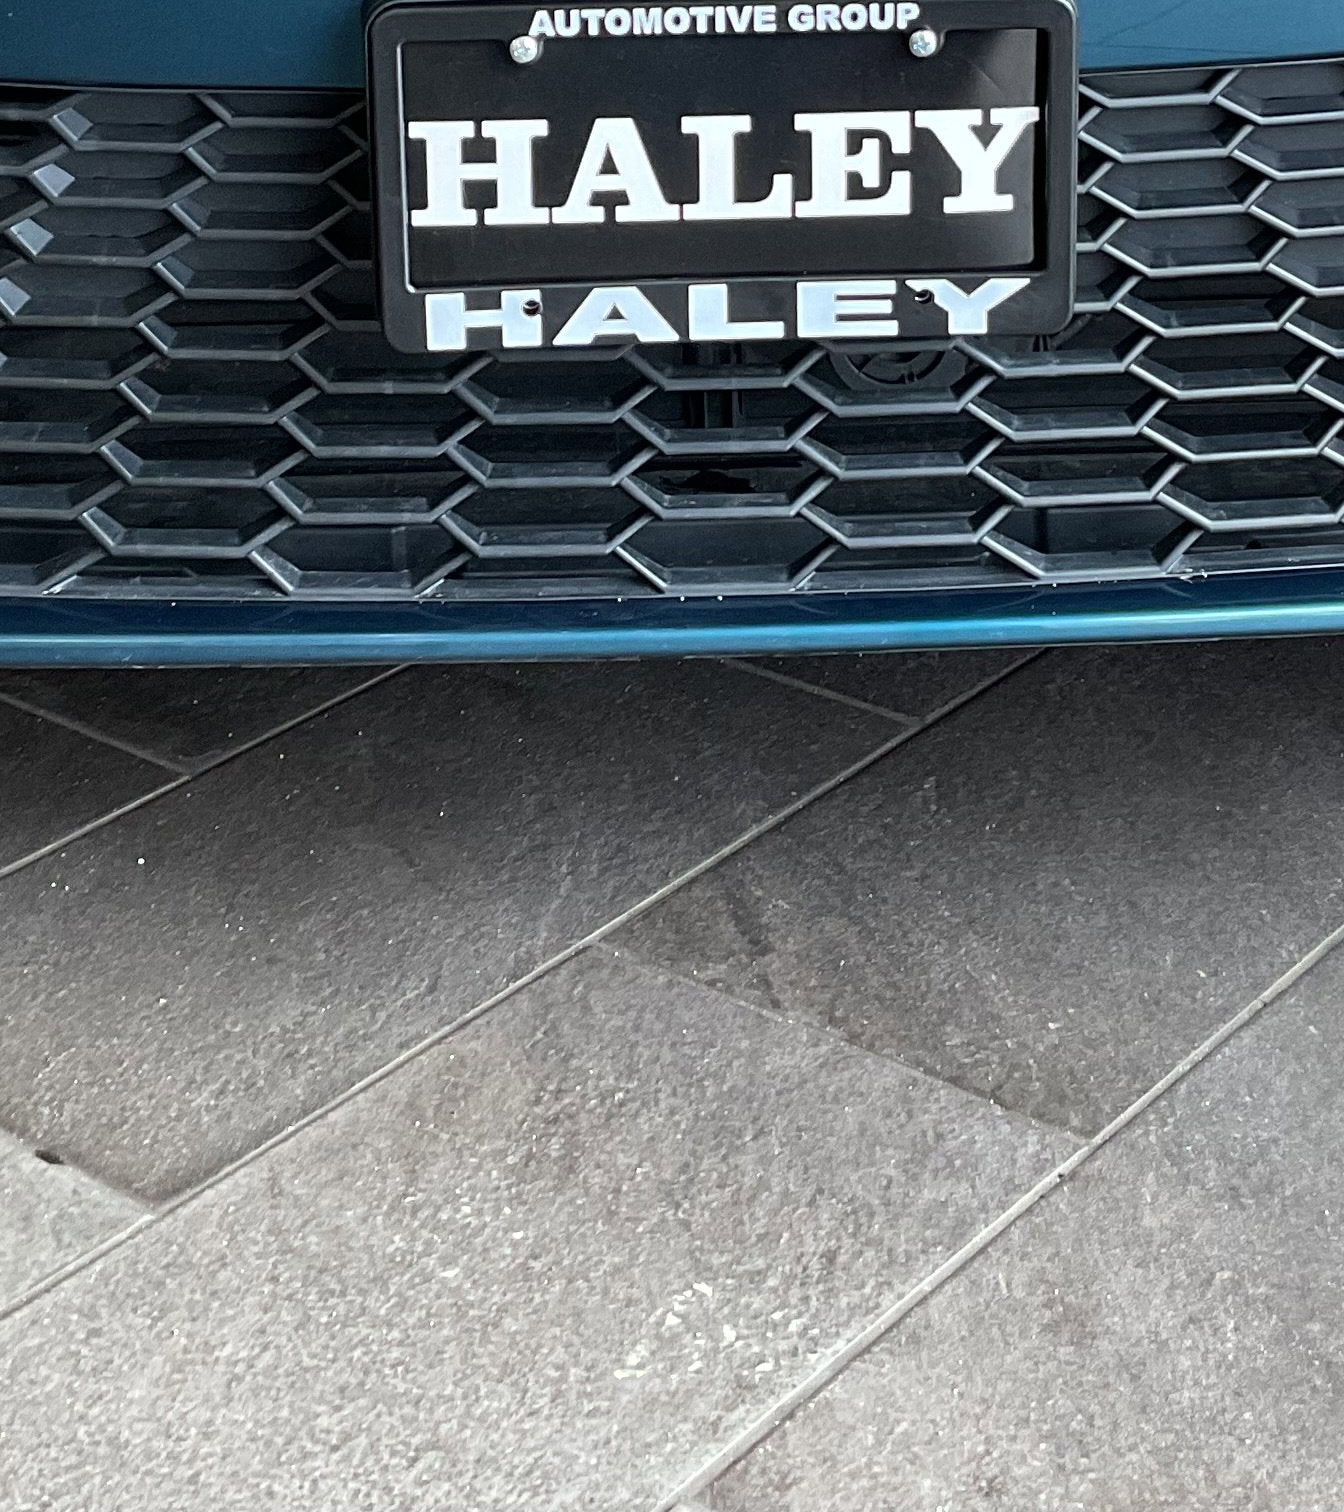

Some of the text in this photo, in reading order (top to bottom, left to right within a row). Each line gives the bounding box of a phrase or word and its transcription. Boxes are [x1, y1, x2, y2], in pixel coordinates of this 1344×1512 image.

[528, 1, 921, 39] AUTOMOTIVE GROUP
[407, 105, 1040, 227] HALEY
[424, 277, 1032, 351] HALEY
